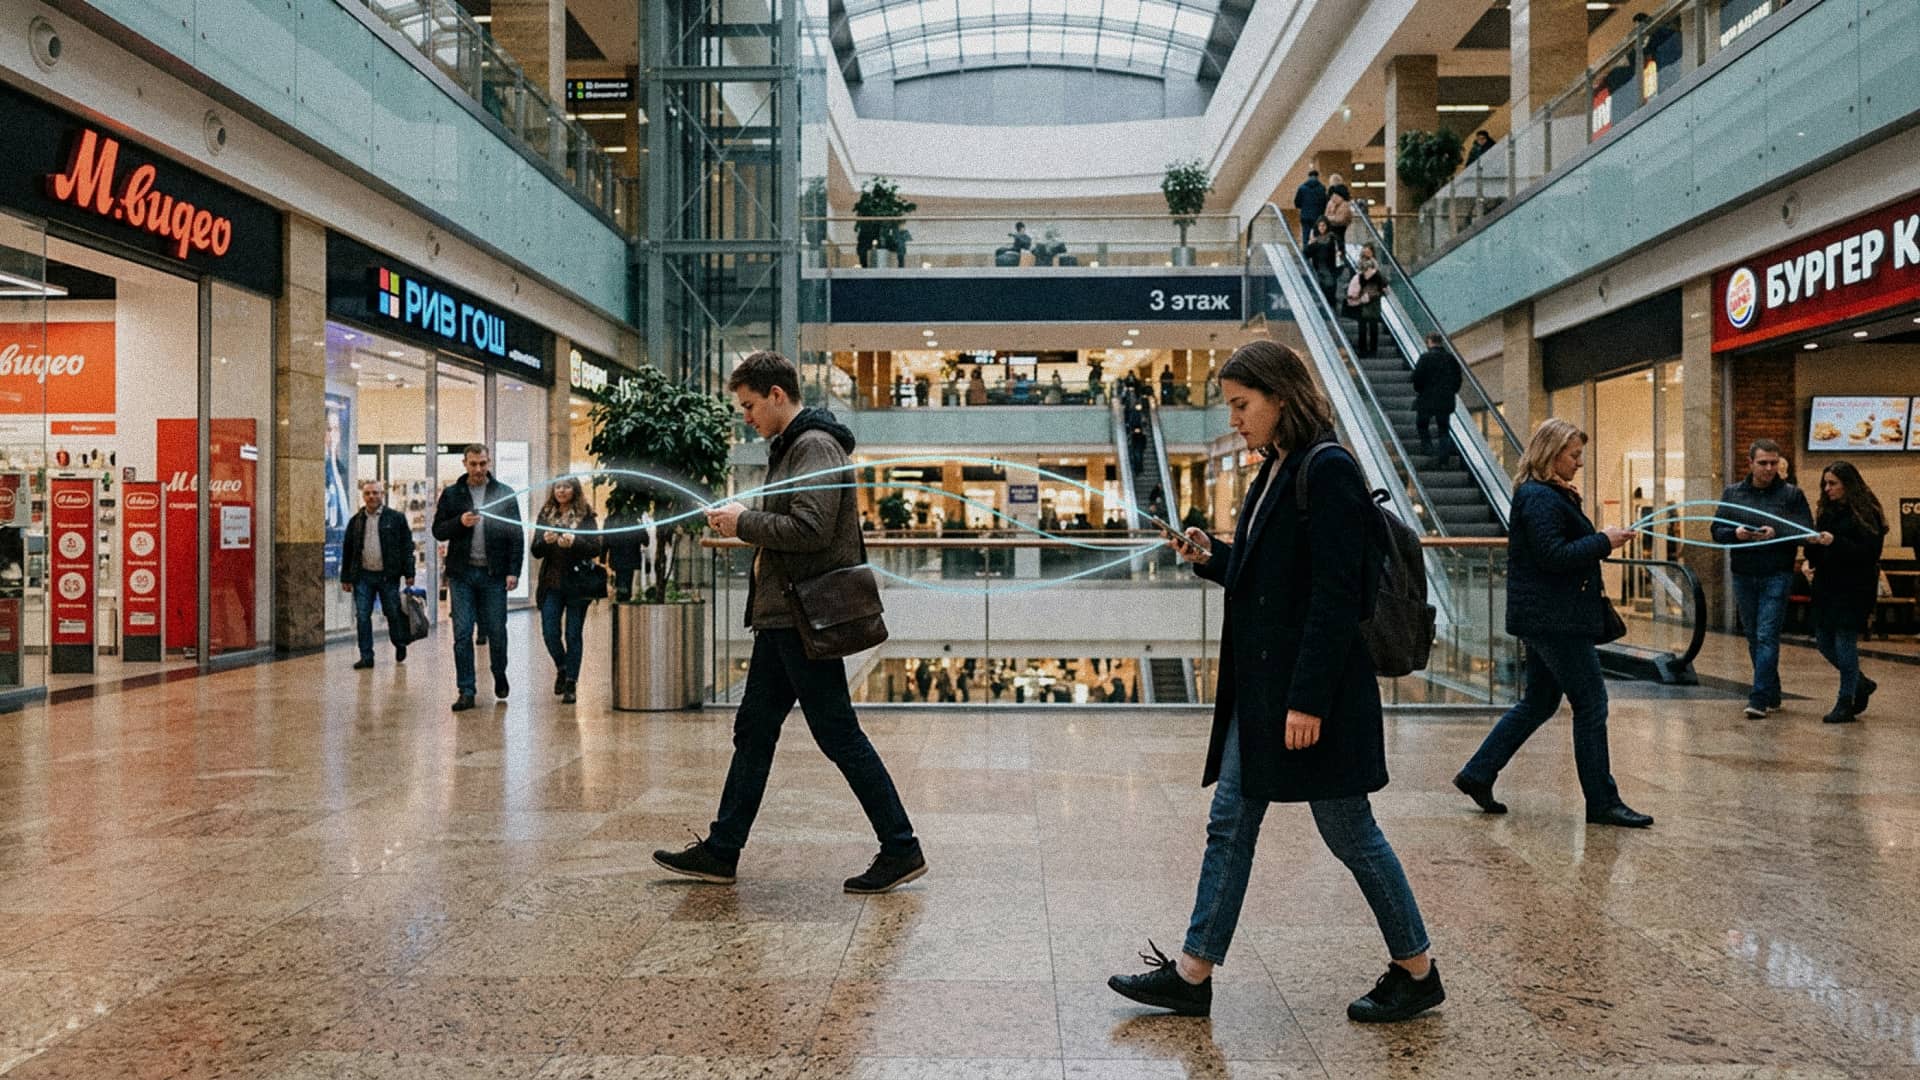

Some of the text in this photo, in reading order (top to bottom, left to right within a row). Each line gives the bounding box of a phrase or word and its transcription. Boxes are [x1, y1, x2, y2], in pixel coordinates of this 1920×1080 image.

[53, 127, 233, 260] М.видео
[1150, 289, 1231, 311] 3 этаж
[1766, 228, 1885, 309] БУРГЕР
[1893, 213, 1920, 269] К
[405, 278, 506, 357] РИВ ГОШ
